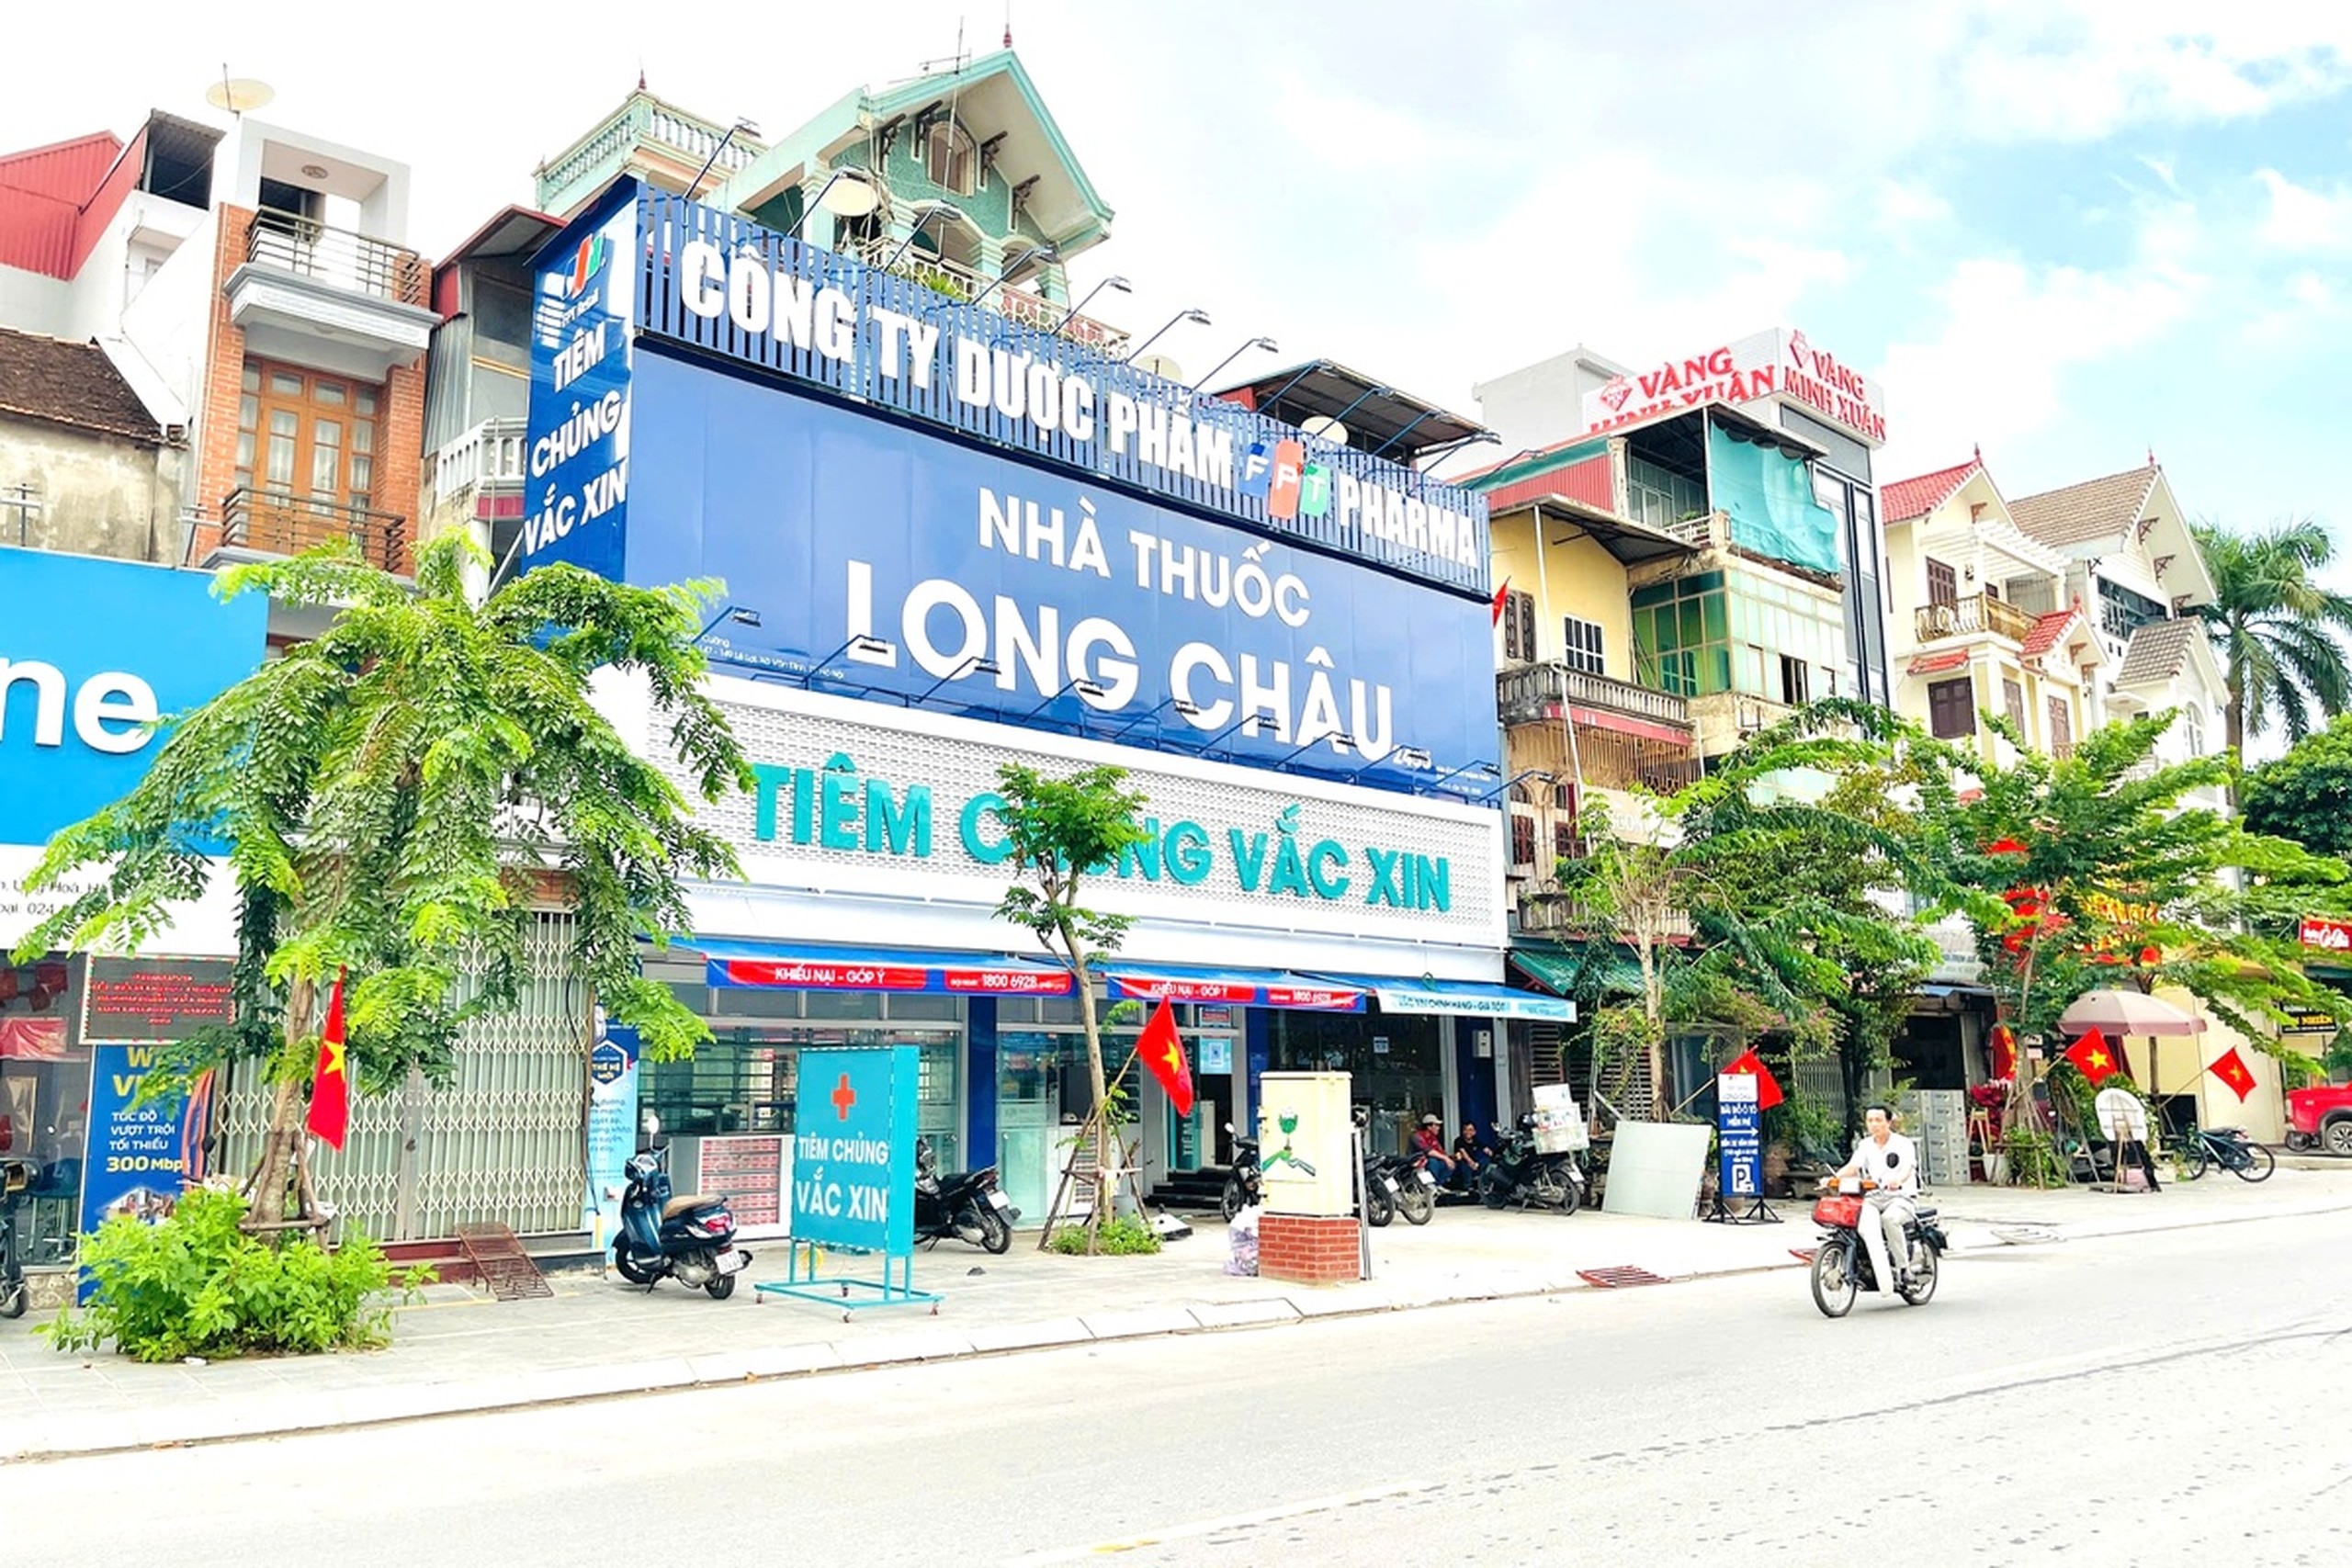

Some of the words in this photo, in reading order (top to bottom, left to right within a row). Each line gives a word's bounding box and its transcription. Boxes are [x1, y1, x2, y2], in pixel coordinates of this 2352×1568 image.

[552, 321, 605, 392] TIÊM
[1638, 346, 1734, 400] VÀNG
[1811, 350, 1866, 401] VÀNG
[681, 240, 856, 364] CÔNG
[871, 306, 941, 389] TY
[957, 336, 1094, 442] DƯỢC
[1109, 388, 1233, 490] PHẨM
[1243, 450, 1329, 511] FPT
[1339, 475, 1479, 569] PHARMA
[1784, 366, 1834, 412] MINH
[1837, 395, 1887, 442] XUÂN
[532, 389, 623, 479] CHỦNG
[524, 484, 576, 556] VẮC
[580, 465, 627, 525] XIN
[978, 487, 1110, 578] NHÀ
[1129, 530, 1311, 627] THUỐC
[847, 559, 1139, 711] LONG
[1169, 642, 1393, 762] CHÂU
[752, 750, 933, 858] TIÊM
[959, 792, 1213, 886] CNG
[1229, 803, 1350, 899] VẮC
[1365, 847, 1451, 912] XIN
[27, 902, 55, 915] 024
[813, 968, 835, 986] NẠI
[845, 967, 876, 984] GÓP
[876, 968, 886, 984] Ý
[982, 974, 1008, 988] 1800
[1010, 975, 1038, 988] 6928
[139, 1109, 157, 1122] ĐỘ
[106, 1156, 149, 1173] 300
[151, 1158, 190, 1173] Mbp
[109, 1138, 130, 1151] TỐI
[797, 1135, 828, 1161] TIÊM
[831, 1131, 889, 1166] CHỦNG
[797, 1164, 841, 1217] VẮC
[848, 1184, 888, 1224] XIN
